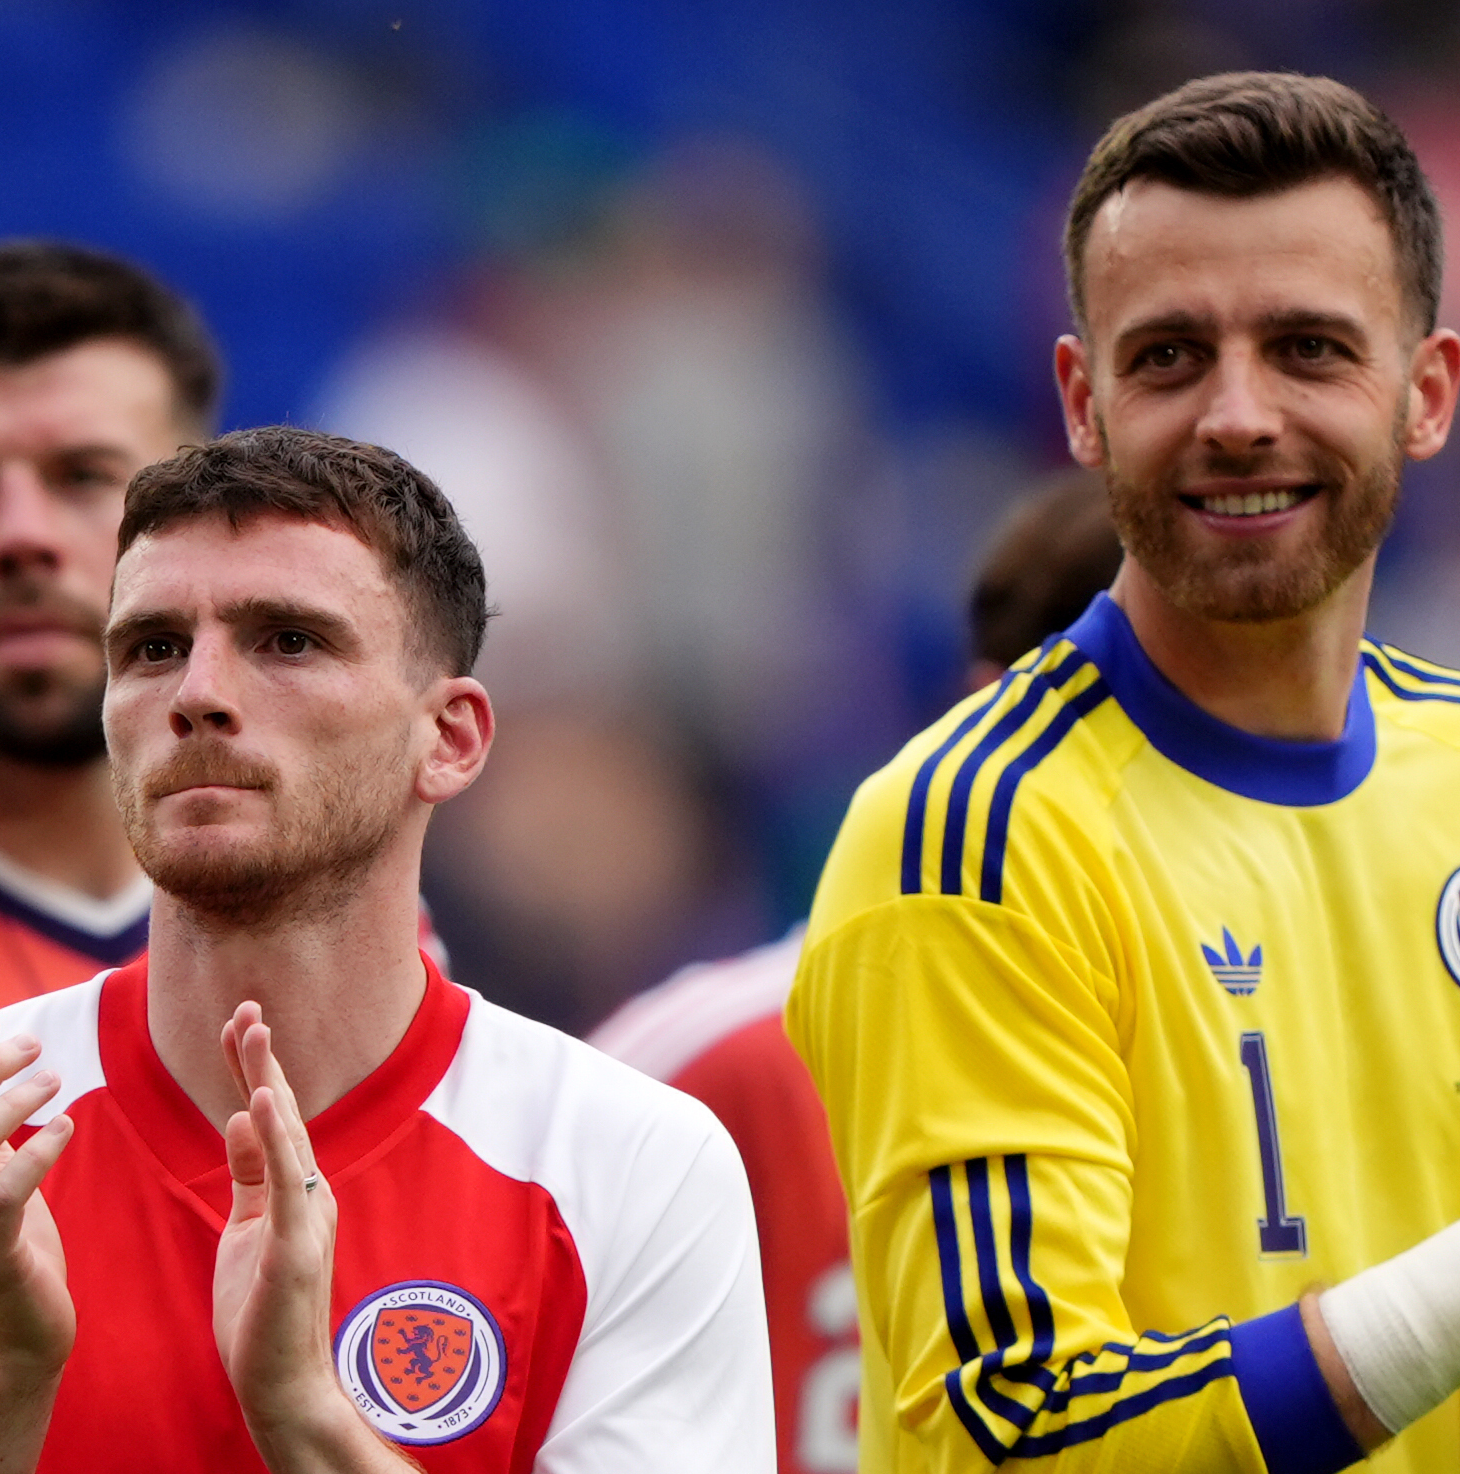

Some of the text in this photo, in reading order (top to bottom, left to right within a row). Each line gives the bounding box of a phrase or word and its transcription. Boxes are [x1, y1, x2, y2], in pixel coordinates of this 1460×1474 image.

[1240, 1031, 1307, 1260] 1
[389, 1291, 466, 1314] SCOTLAND
[355, 1392, 376, 1413] EST
[443, 1408, 469, 1428] 1873
